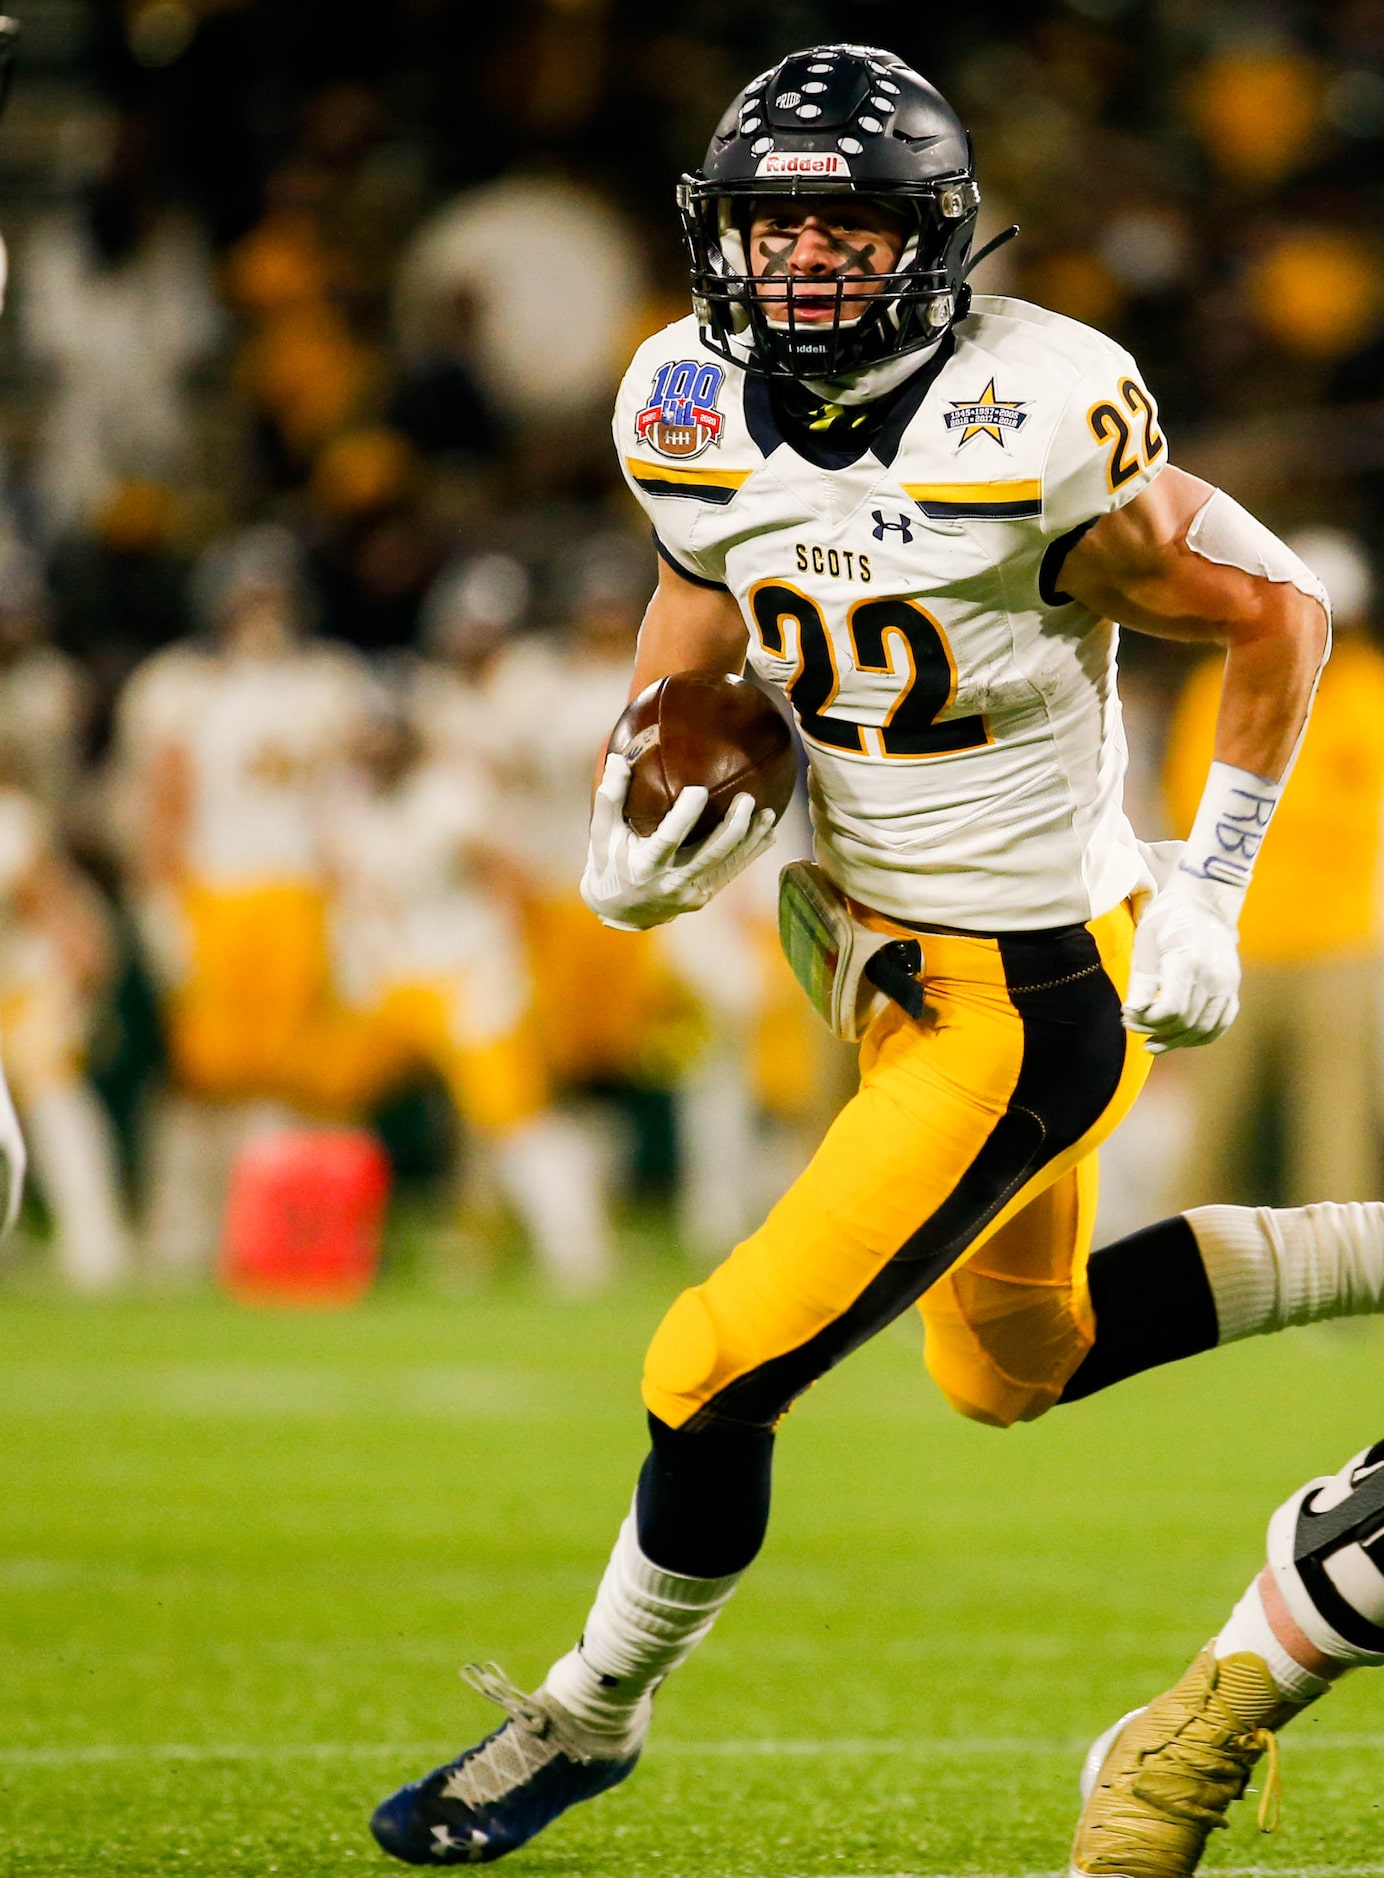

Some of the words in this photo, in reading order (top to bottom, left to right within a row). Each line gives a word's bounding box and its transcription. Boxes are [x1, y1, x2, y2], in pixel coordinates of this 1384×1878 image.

[766, 156, 838, 172] Riddell
[648, 361, 723, 409] 100
[660, 399, 696, 425] UIL
[1085, 376, 1165, 495] 22
[795, 543, 873, 583] SCOTS
[748, 578, 996, 761] 22
